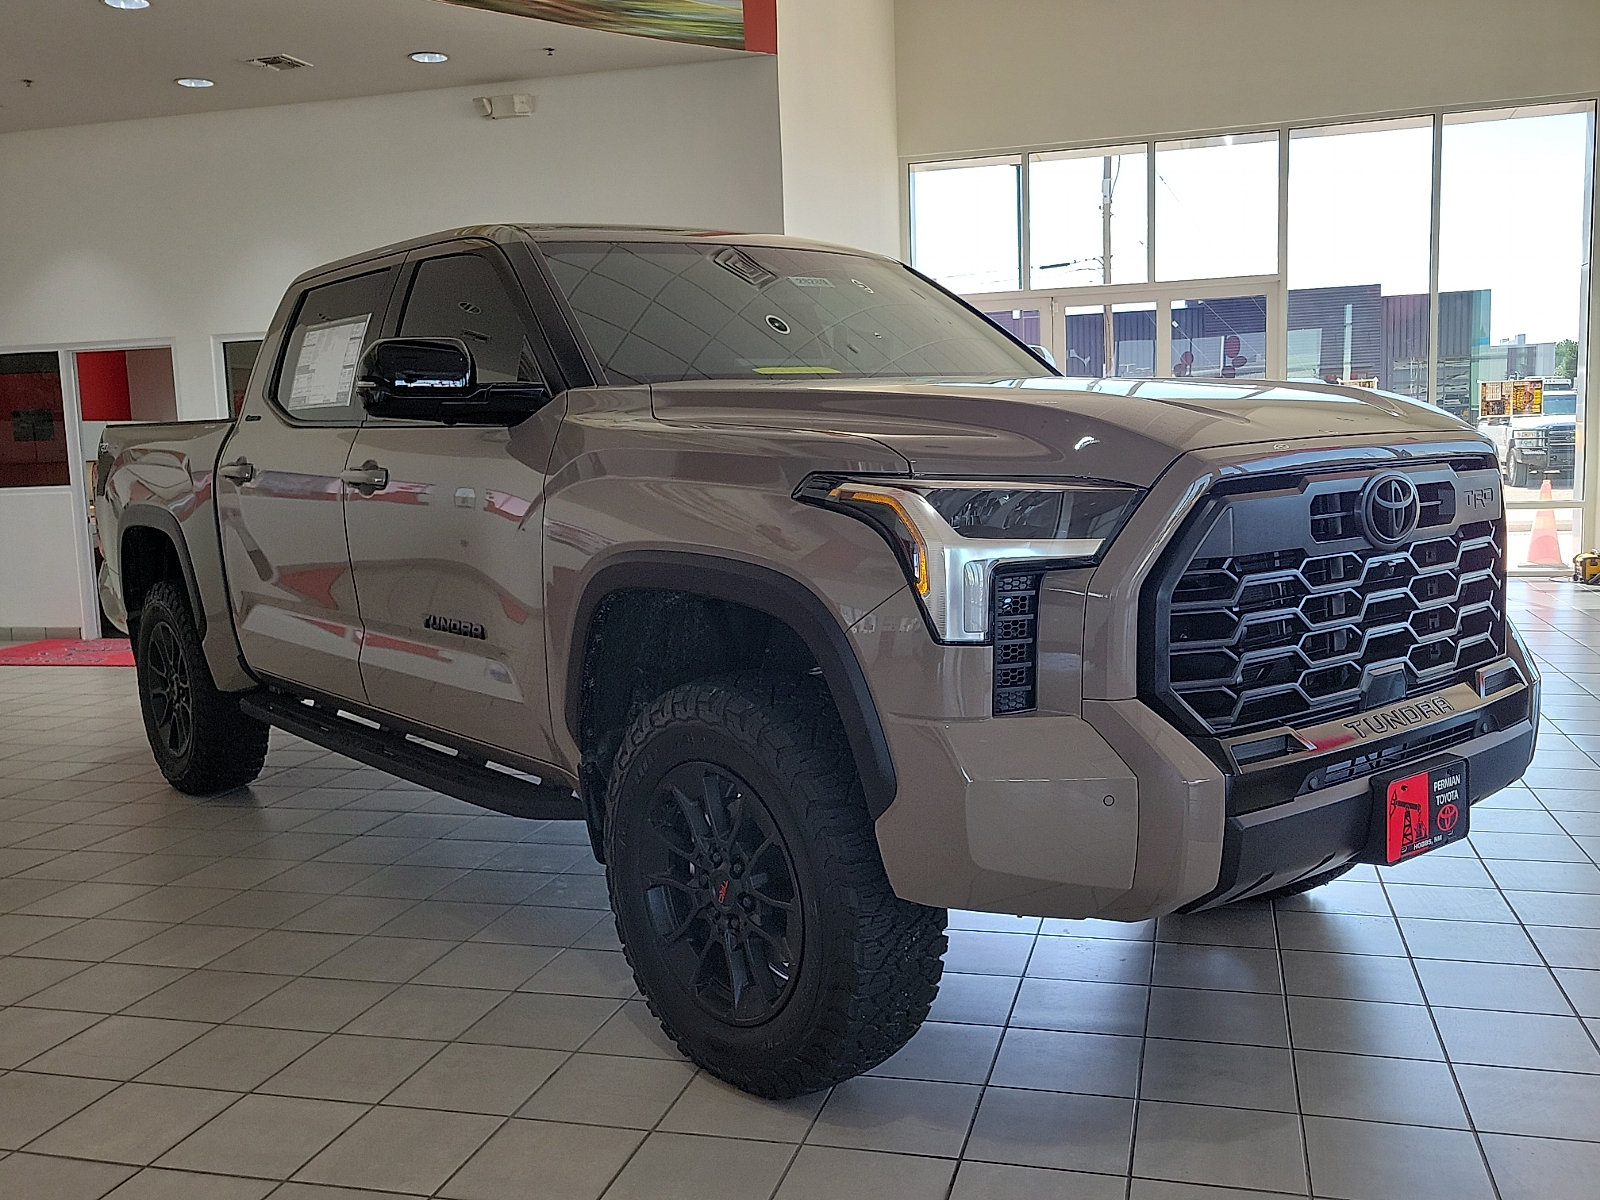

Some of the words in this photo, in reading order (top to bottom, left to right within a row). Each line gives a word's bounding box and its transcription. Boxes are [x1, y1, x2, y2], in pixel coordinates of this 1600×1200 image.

[1463, 487, 1494, 509] TRD
[424, 614, 486, 640] TUNDRA
[1342, 696, 1455, 738] TUNDRA
[1433, 774, 1461, 792] PERMIAN
[1435, 789, 1459, 806] TOYOTA
